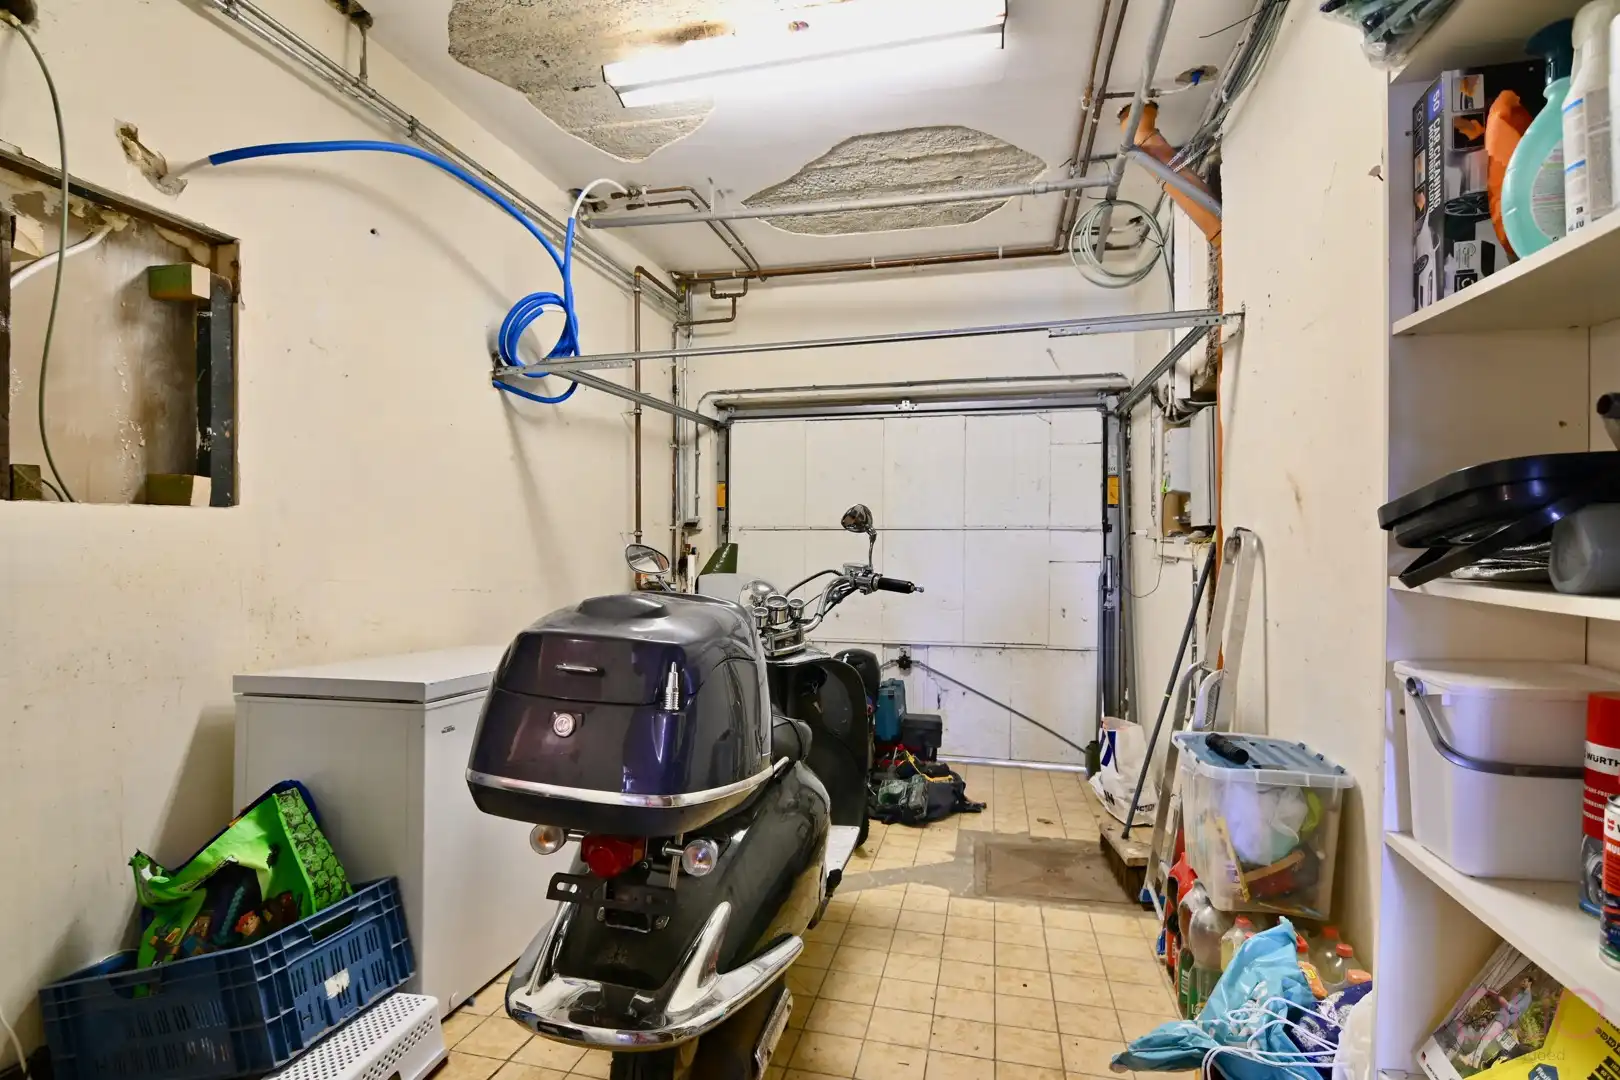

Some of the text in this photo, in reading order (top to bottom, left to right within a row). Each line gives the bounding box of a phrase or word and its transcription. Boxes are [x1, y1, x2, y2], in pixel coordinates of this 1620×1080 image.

[1432, 89, 1440, 112] 50
[1432, 117, 1441, 208] CAR CLEANING
